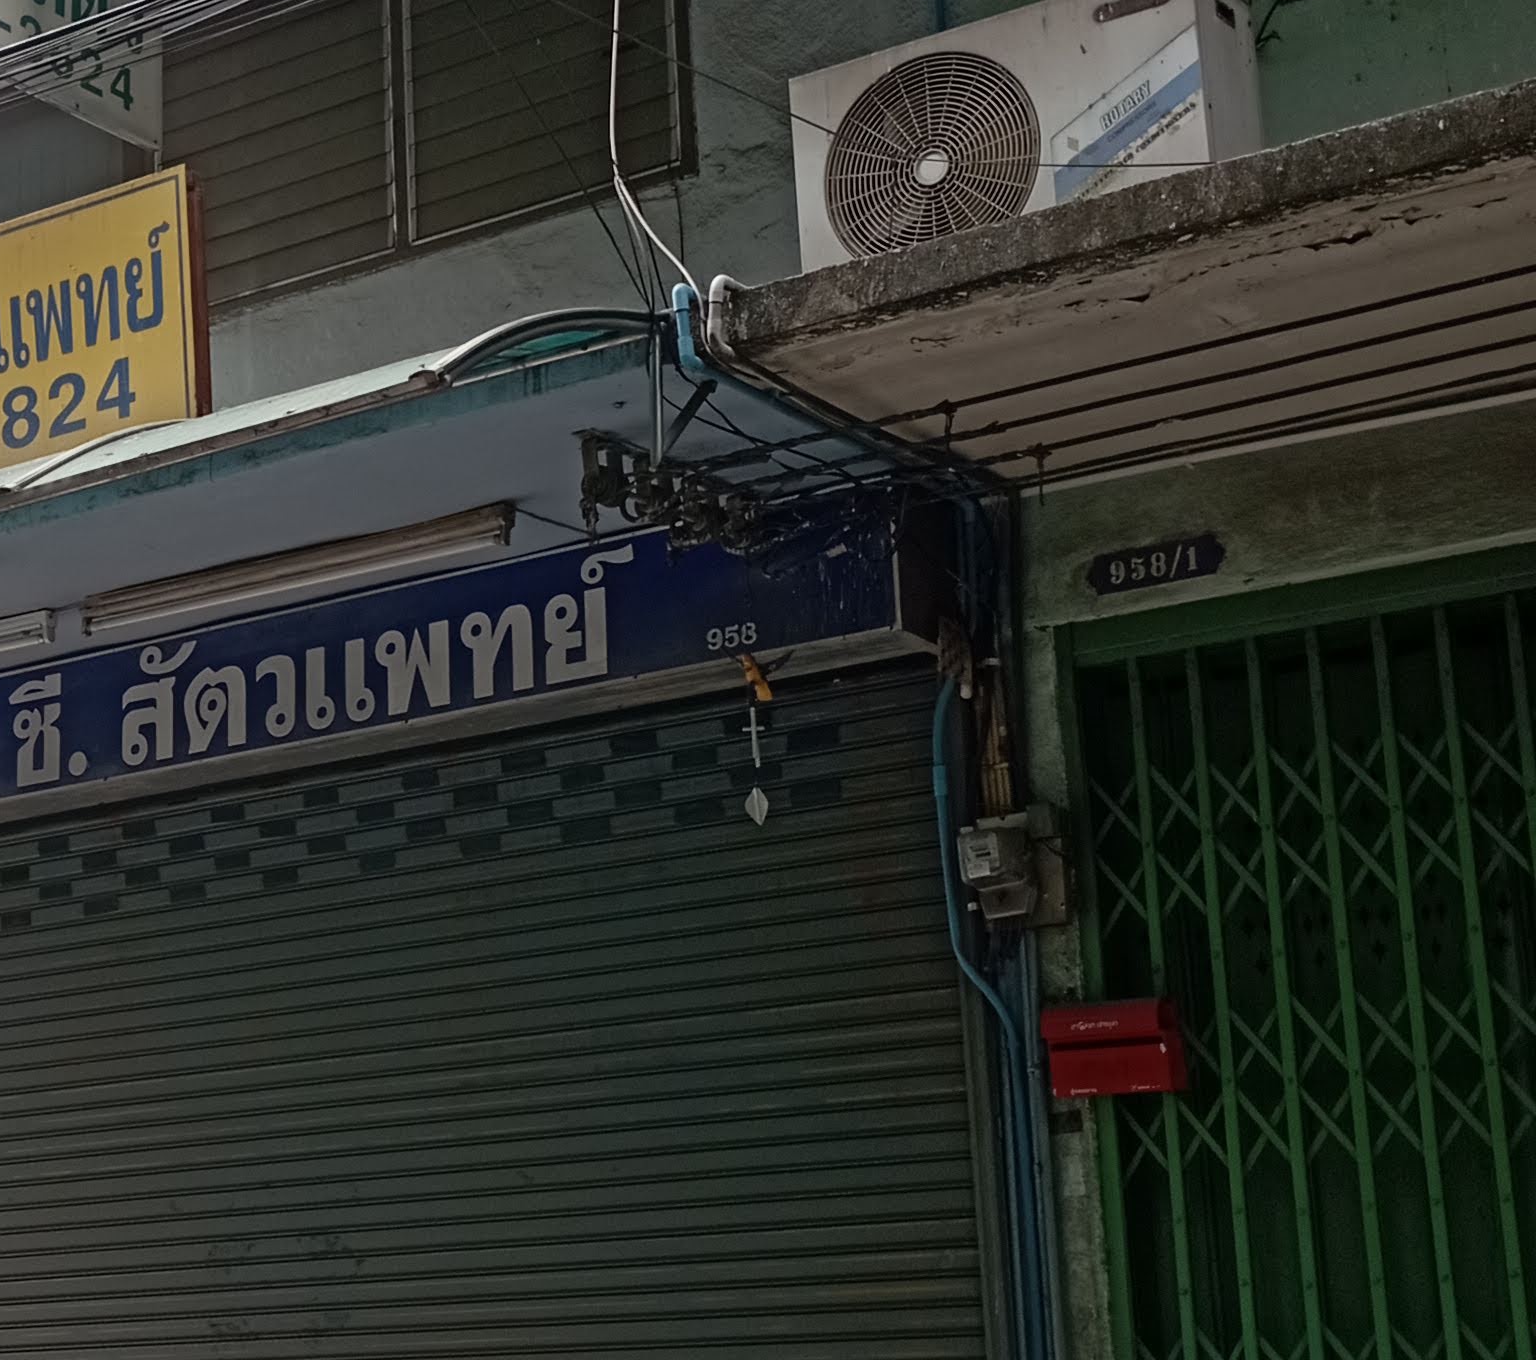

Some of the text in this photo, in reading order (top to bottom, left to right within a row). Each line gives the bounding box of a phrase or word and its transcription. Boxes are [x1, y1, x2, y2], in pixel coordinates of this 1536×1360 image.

[1099, 79, 1151, 132] ROTARY
[1109, 544, 1199, 585] 958/1
[121, 543, 634, 767] สัตวแพทย์
[706, 621, 757, 651] 958
